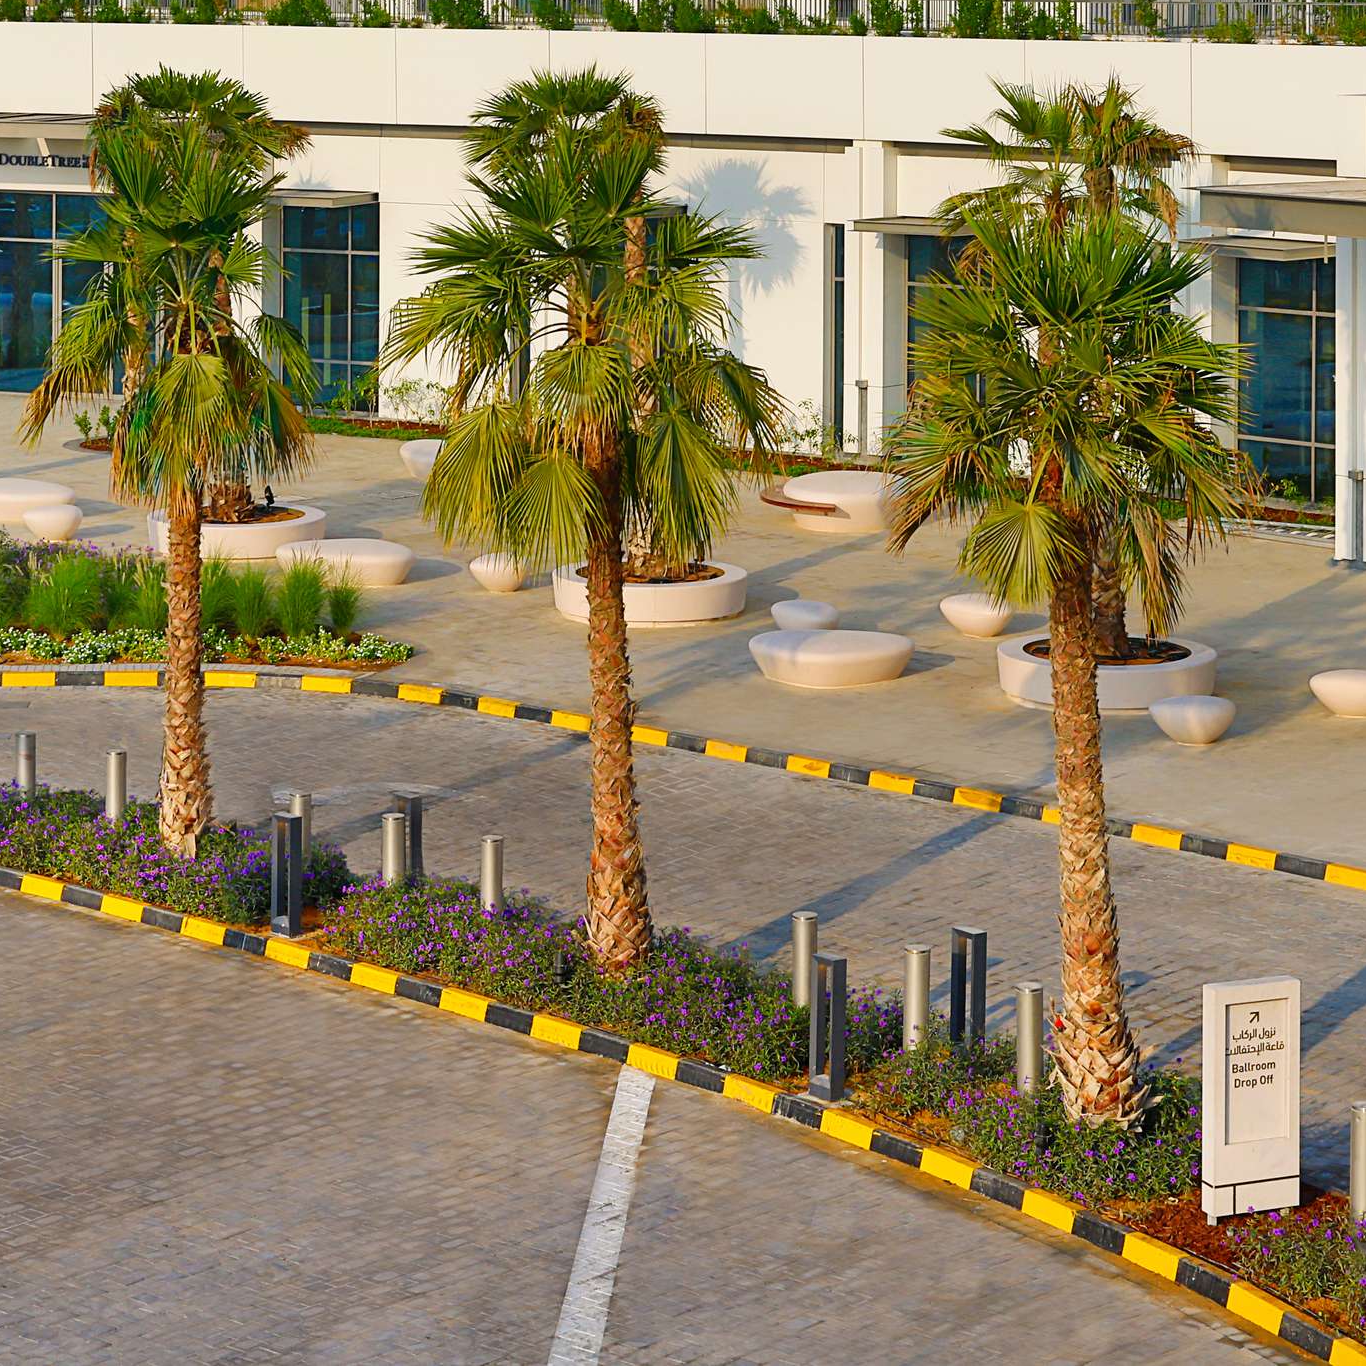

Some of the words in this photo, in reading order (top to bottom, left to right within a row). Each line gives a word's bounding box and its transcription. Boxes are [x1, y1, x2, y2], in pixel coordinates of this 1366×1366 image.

[1232, 1028, 1257, 1042] الركاب
[1259, 1027, 1276, 1039] نزول
[1266, 1040, 1285, 1051] قاعة
[1232, 1061, 1276, 1074] Ballroom
[1234, 1078, 1257, 1089] Drop
[1260, 1074, 1274, 1085] Off
